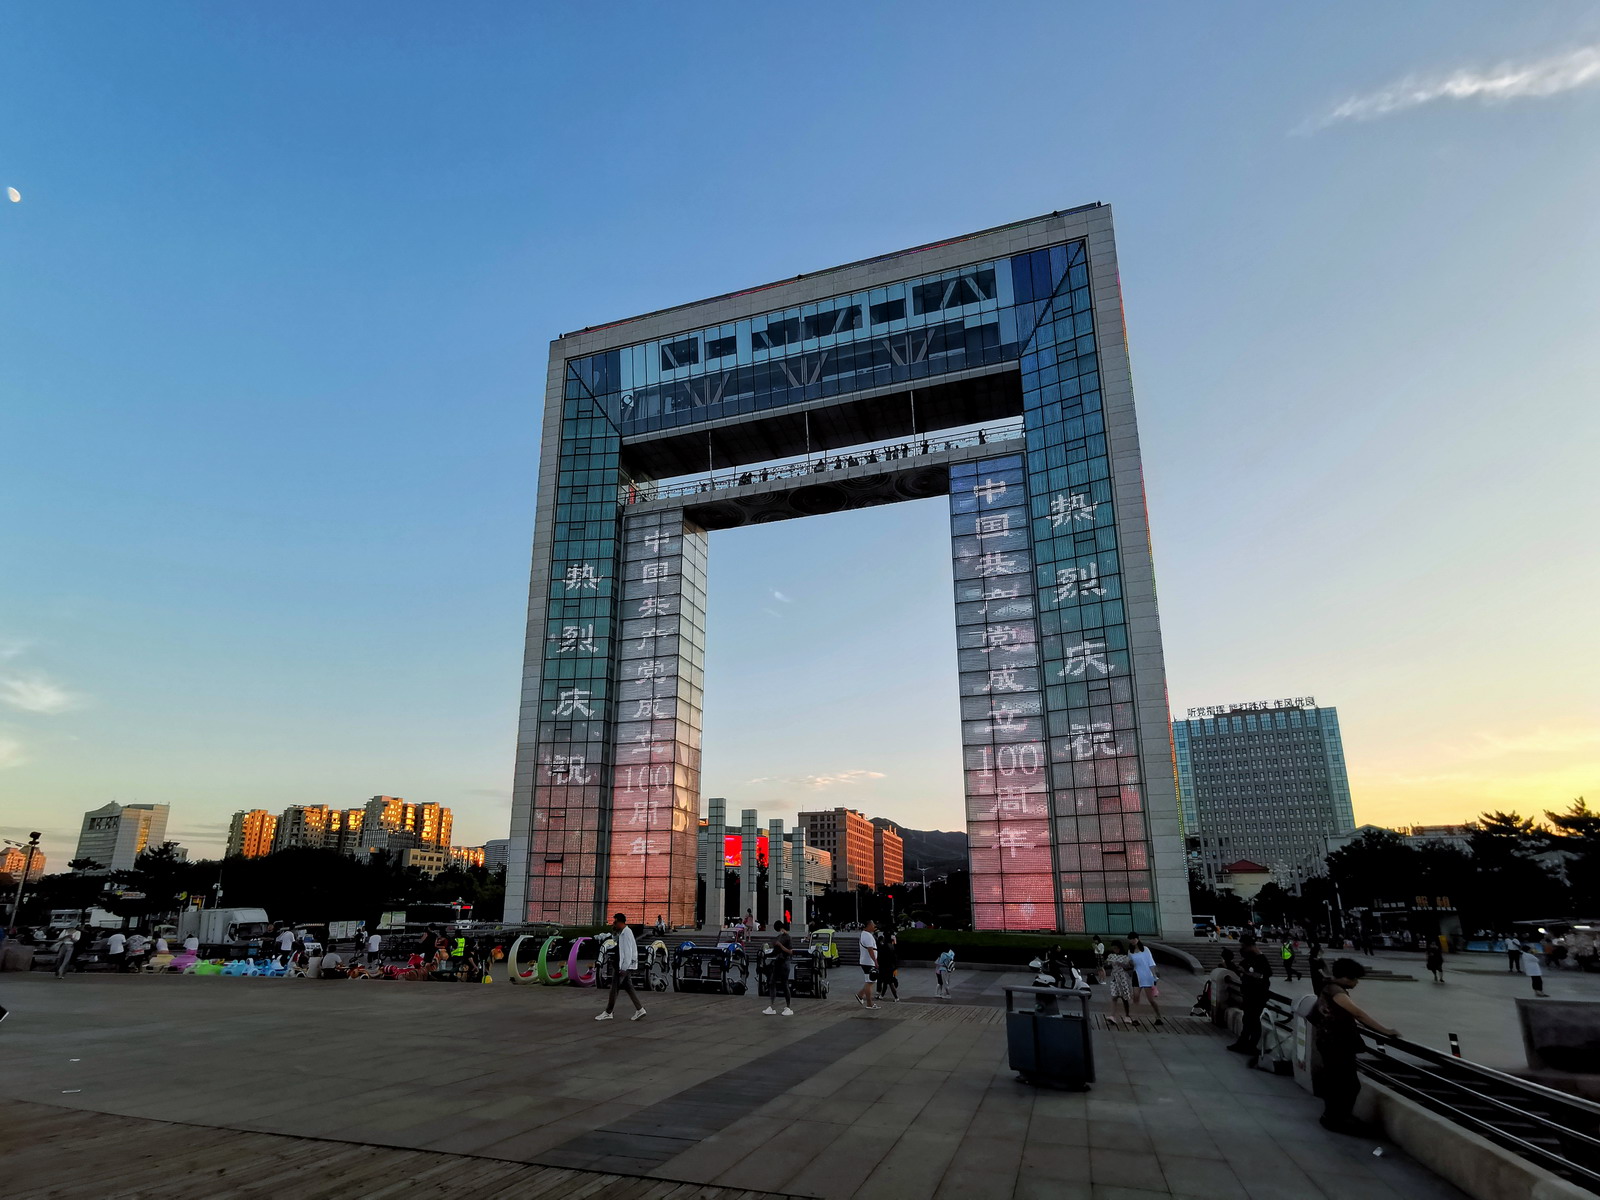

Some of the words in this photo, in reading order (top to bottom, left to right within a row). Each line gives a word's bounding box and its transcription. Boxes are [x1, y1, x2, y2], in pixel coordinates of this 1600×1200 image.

[545, 563, 604, 784] 热烈庆祝
[1046, 492, 1123, 760] 热烈庆祝
